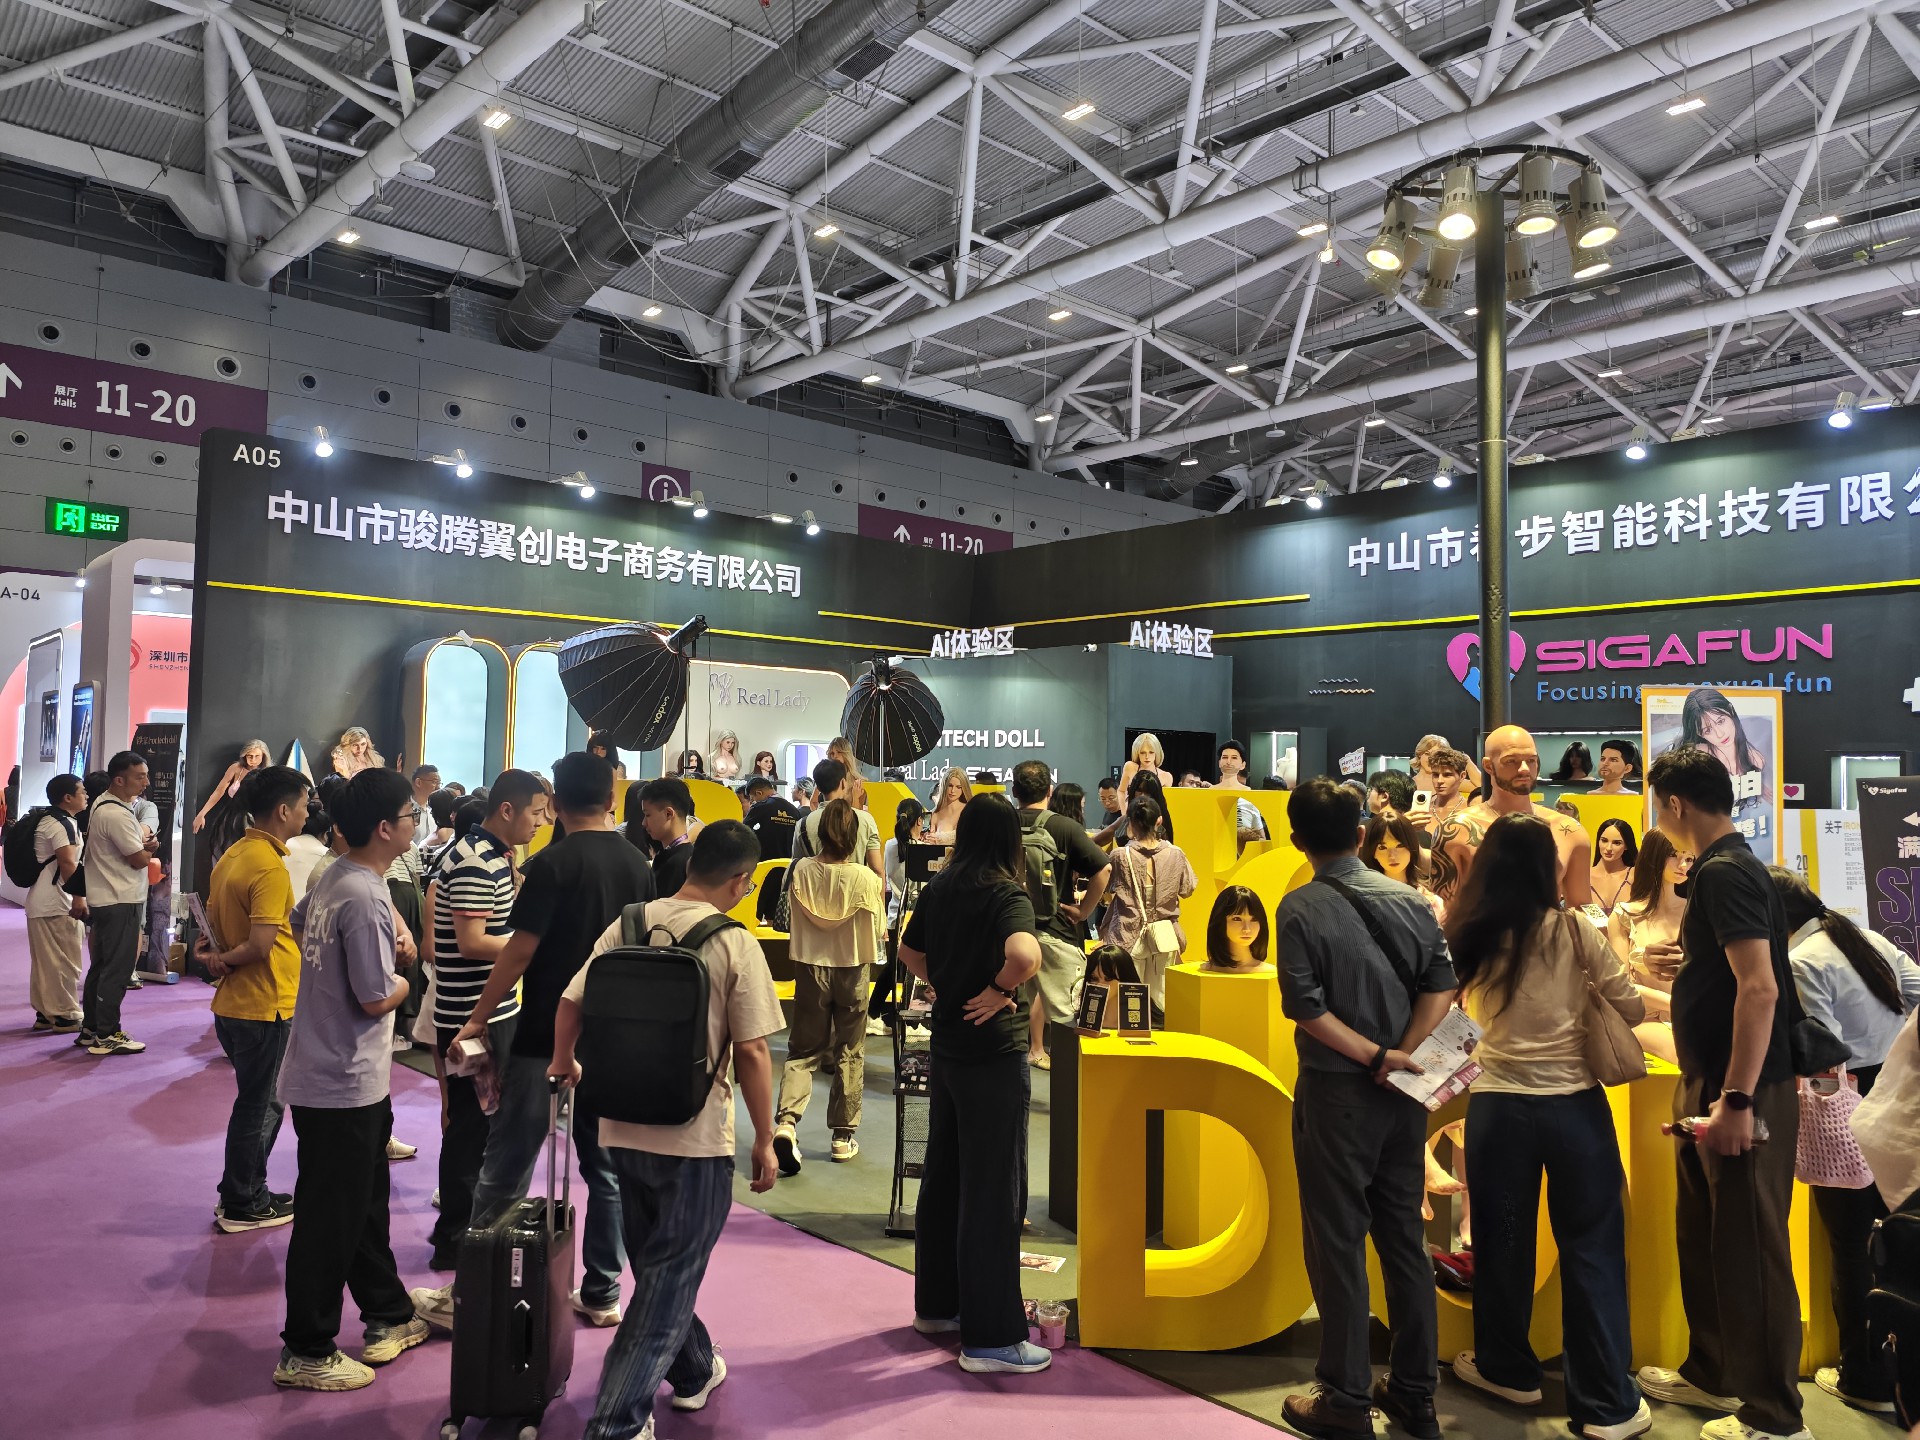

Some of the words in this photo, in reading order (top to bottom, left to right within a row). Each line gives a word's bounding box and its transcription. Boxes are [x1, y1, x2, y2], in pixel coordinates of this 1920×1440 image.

[53, 396, 77, 409] Halls
[54, 384, 78, 398] 展厅
[96, 380, 196, 427] 11-20
[233, 443, 282, 469] A05
[90, 521, 120, 532] EXIT
[91, 512, 120, 524] 出口
[1348, 466, 1920, 578] 中山市步智能科技有限
[267, 489, 802, 599] 中山市骏腾翼创电子商务有限公司
[940, 531, 984, 556] 11-20
[1, 586, 41, 601] A-04
[929, 626, 1015, 659] Ai体验区
[1129, 619, 1214, 659] Ai体验区
[1535, 623, 1834, 673] SIGAFUN
[149, 649, 189, 664] 深圳市
[736, 687, 771, 706] Real
[774, 689, 812, 713] Lady
[1537, 680, 1643, 705] Focusing
[1784, 671, 1834, 693] fun
[936, 728, 989, 748] TECH
[994, 728, 1045, 748] DOLL
[1825, 820, 1842, 834] 关于
